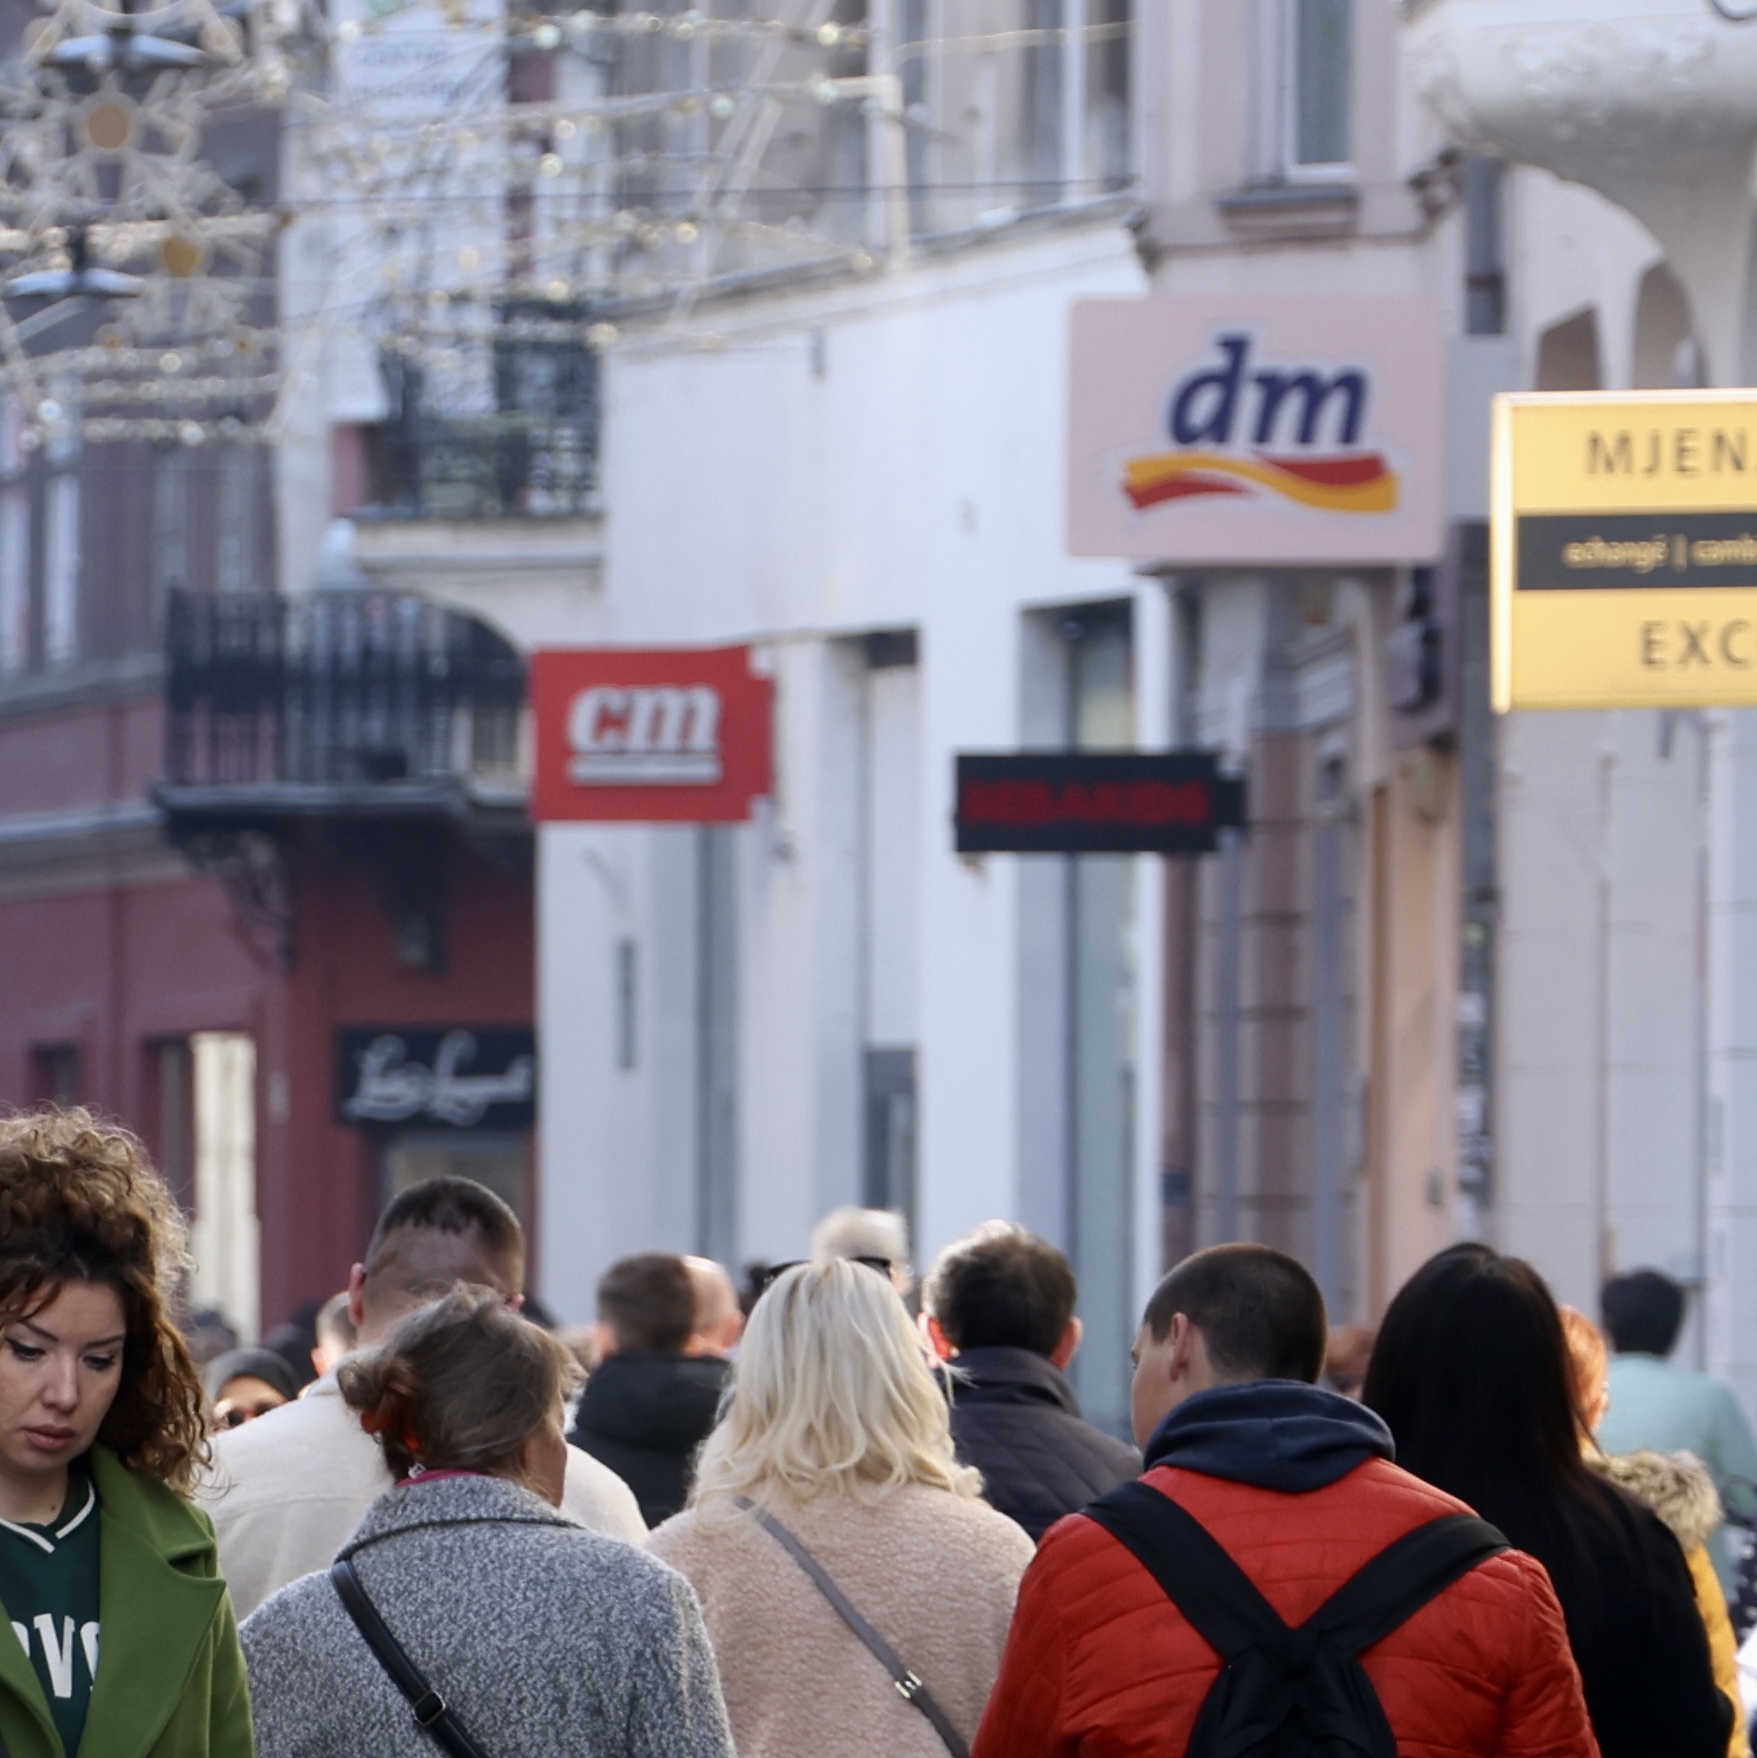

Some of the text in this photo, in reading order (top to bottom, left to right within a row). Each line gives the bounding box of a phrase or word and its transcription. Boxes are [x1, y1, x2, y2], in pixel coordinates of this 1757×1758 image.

[1169, 333, 1369, 446] dm
[1586, 425, 1757, 476] MJEN
[566, 683, 723, 752] cm
